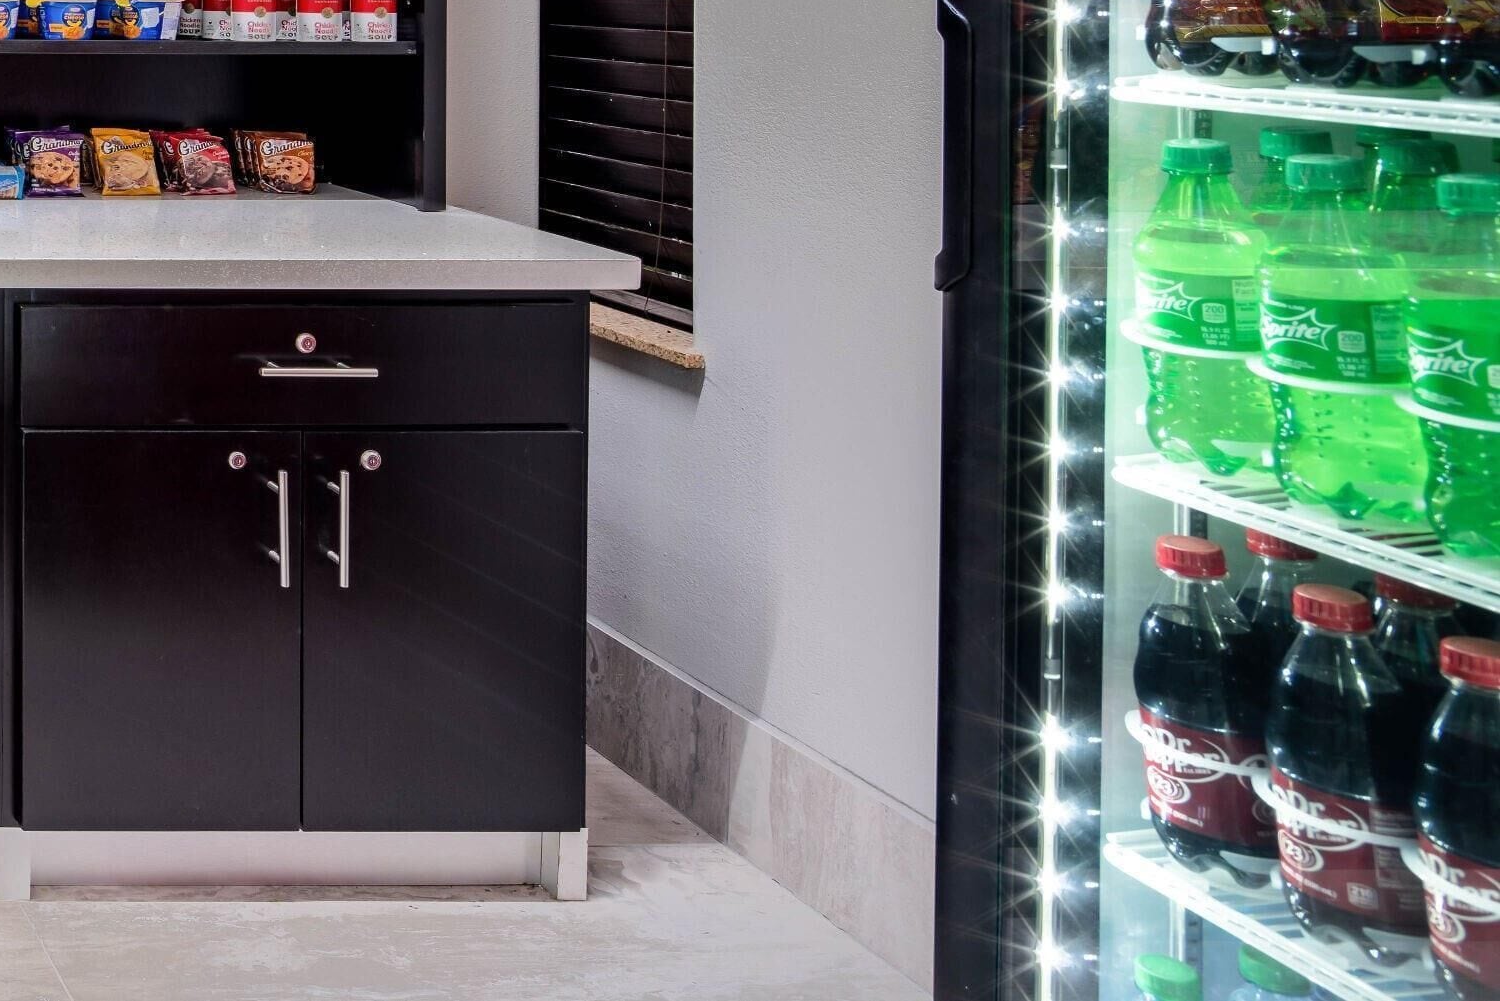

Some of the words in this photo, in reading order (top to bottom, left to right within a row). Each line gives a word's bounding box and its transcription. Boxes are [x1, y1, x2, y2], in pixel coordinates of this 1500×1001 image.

[1204, 305, 1224, 314] 200
[1155, 727, 1192, 753] Dr
[1286, 789, 1326, 816] Dr
[1427, 853, 1465, 884] Dr
